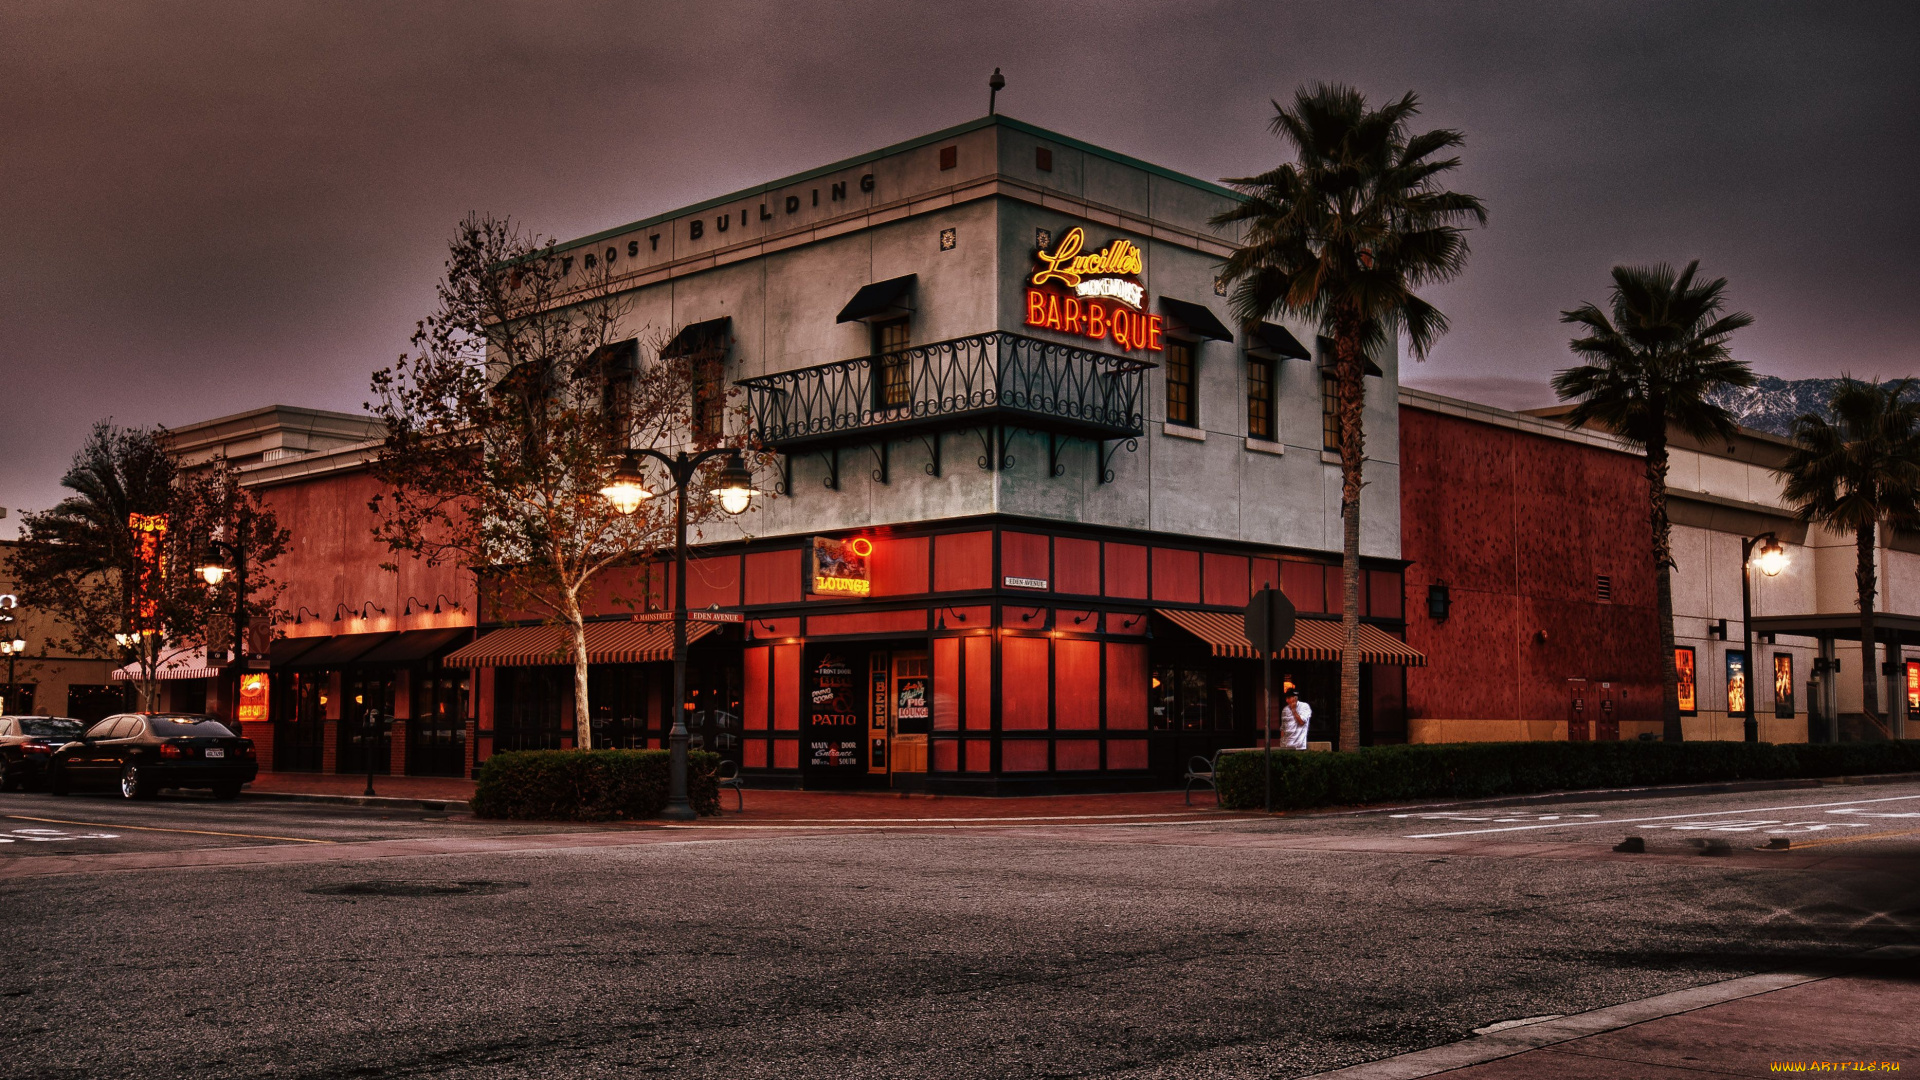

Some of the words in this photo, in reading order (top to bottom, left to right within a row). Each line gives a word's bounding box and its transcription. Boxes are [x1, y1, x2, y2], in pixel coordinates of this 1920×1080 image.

[562, 234, 661, 276] FROST
[690, 173, 875, 240] BUILDING
[1033, 227, 1142, 287] Lucille's
[1075, 278, 1144, 309] SMOKEHOUSE
[816, 577, 870, 593] LOUNGE
[713, 614, 739, 622] AVENUE
[875, 681, 885, 726] BEER
[907, 698, 925, 707] PIG
[898, 707, 929, 718] LOUNGE
[812, 714, 857, 726] PATIO
[814, 748, 853, 757] Entrance
